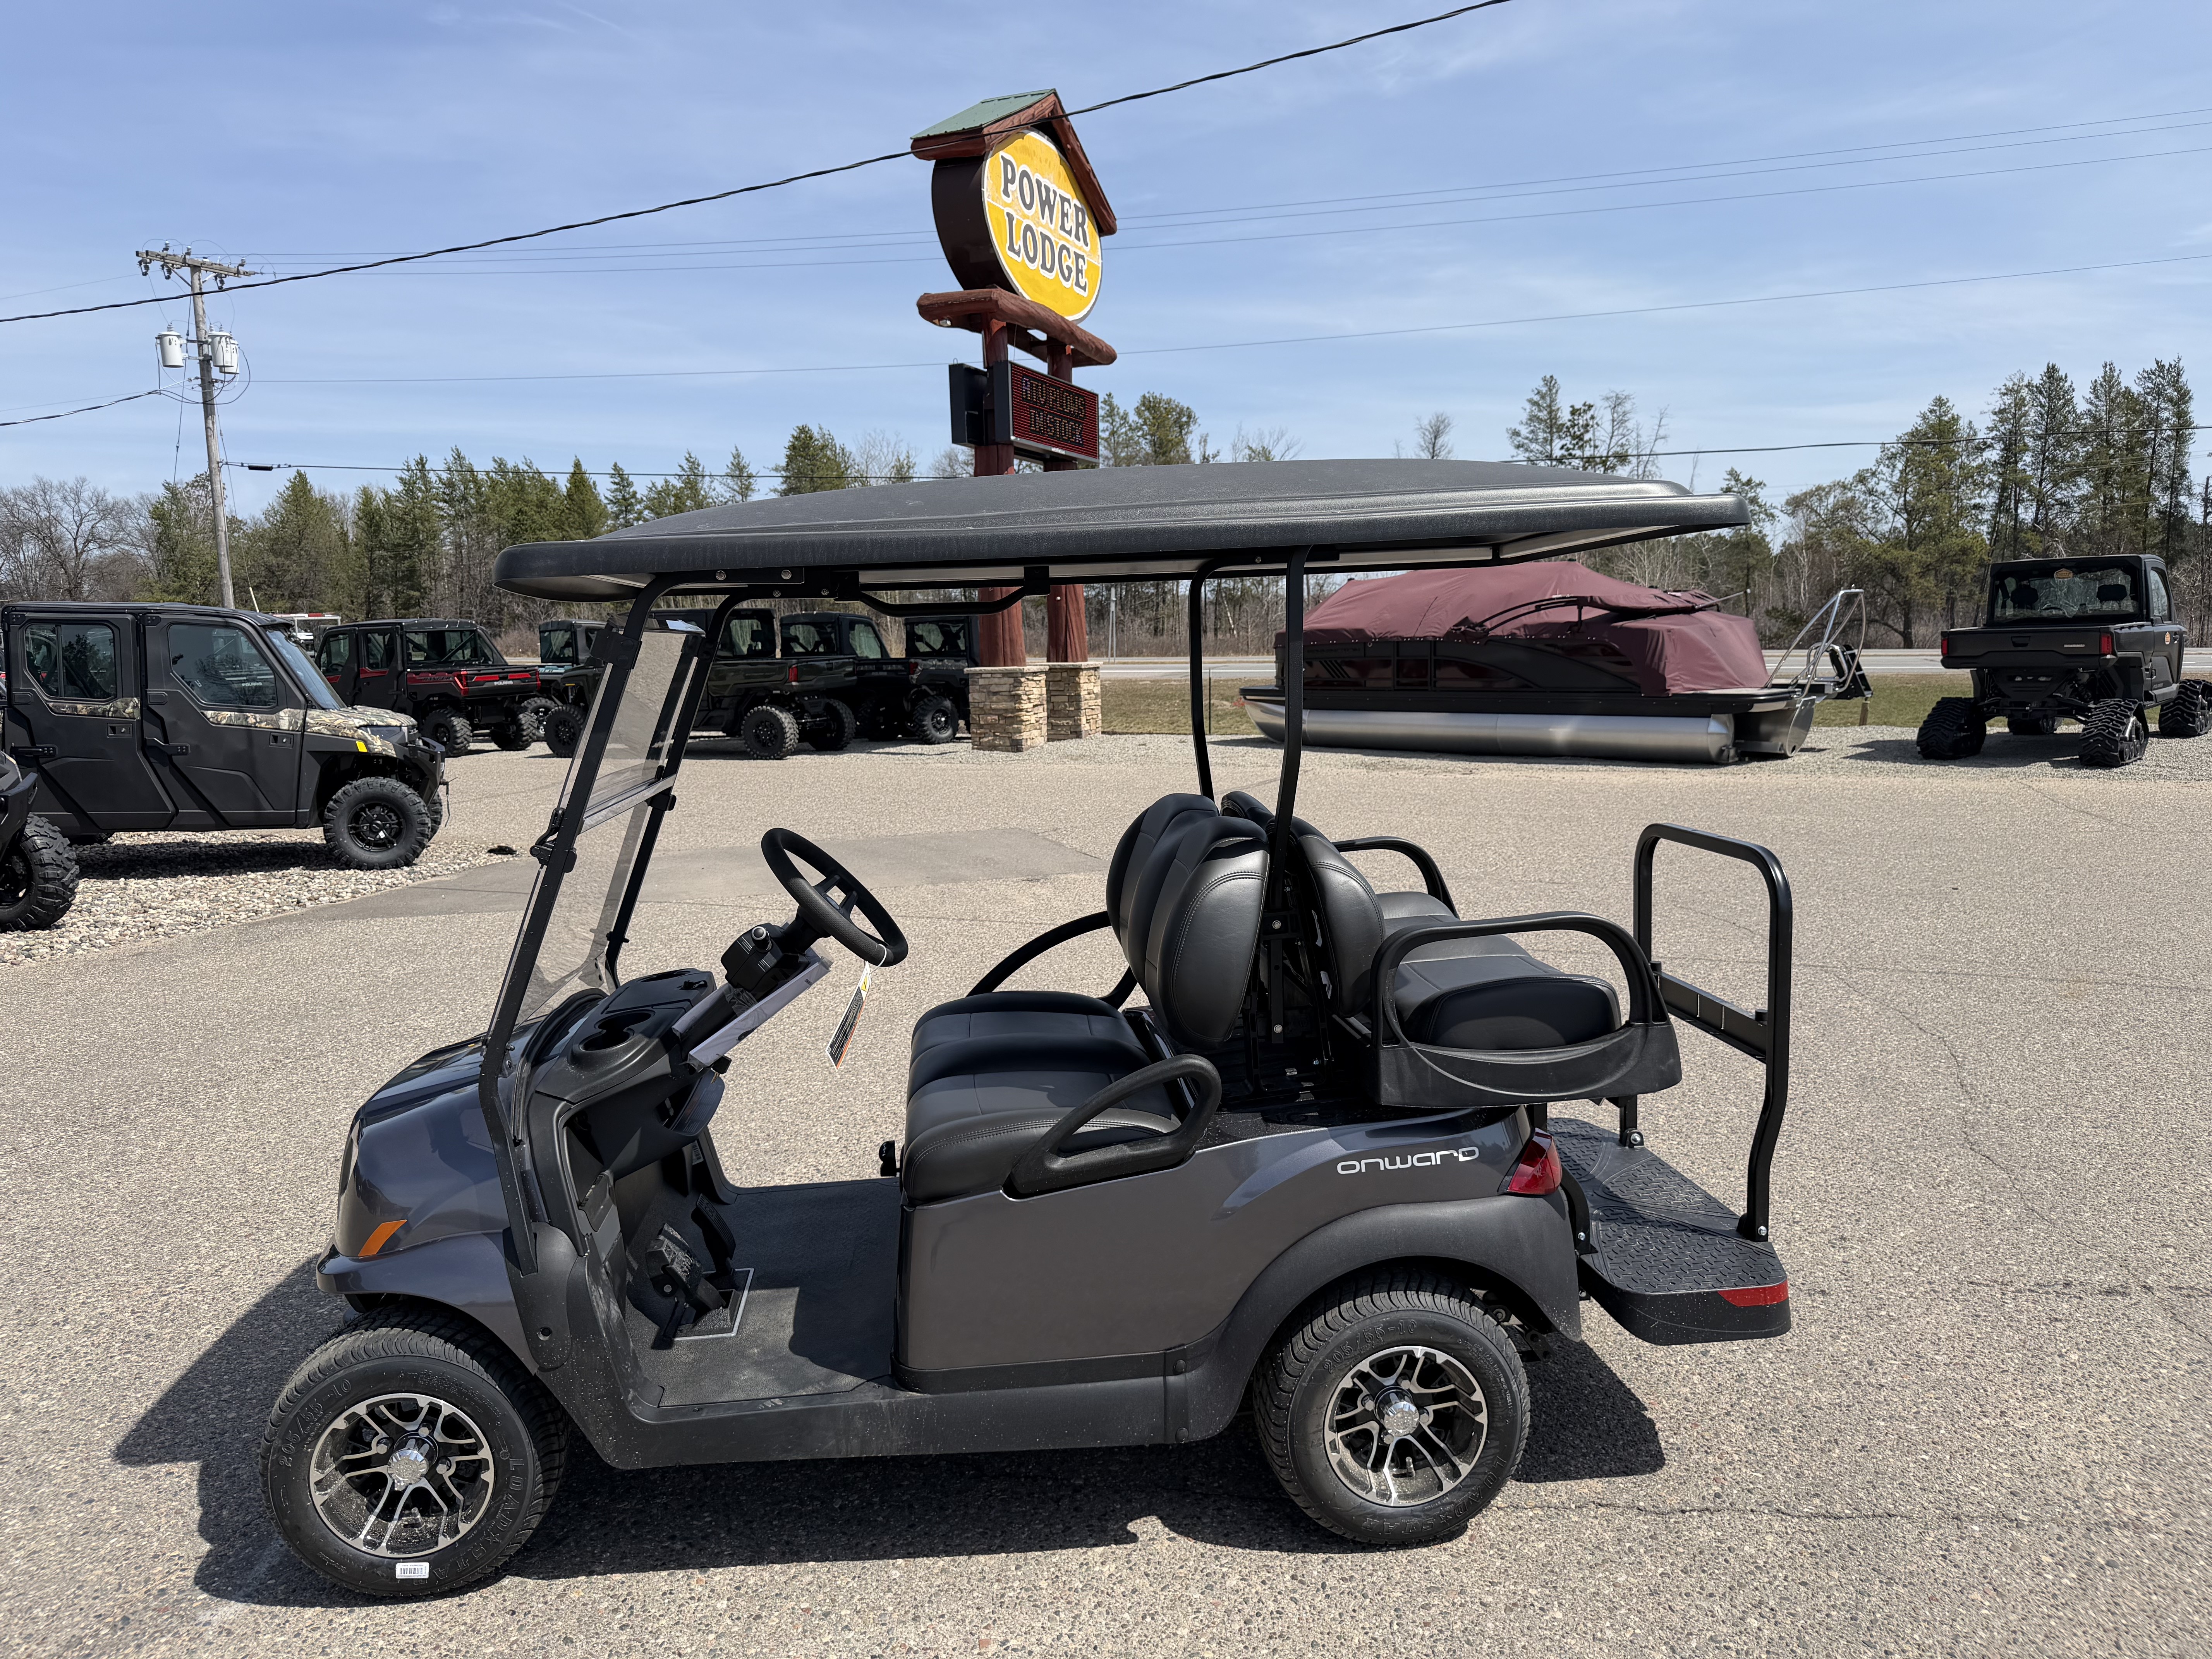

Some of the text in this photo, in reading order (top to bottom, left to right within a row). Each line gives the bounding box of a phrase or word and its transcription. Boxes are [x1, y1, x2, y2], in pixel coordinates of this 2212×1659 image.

[1001, 155, 1089, 247] POWER
[1006, 211, 1087, 292] LODGE
[496, 1458, 524, 1531] LOAD
[1455, 1456, 1507, 1517] LOAD
[1361, 1517, 1434, 1534] STAR
